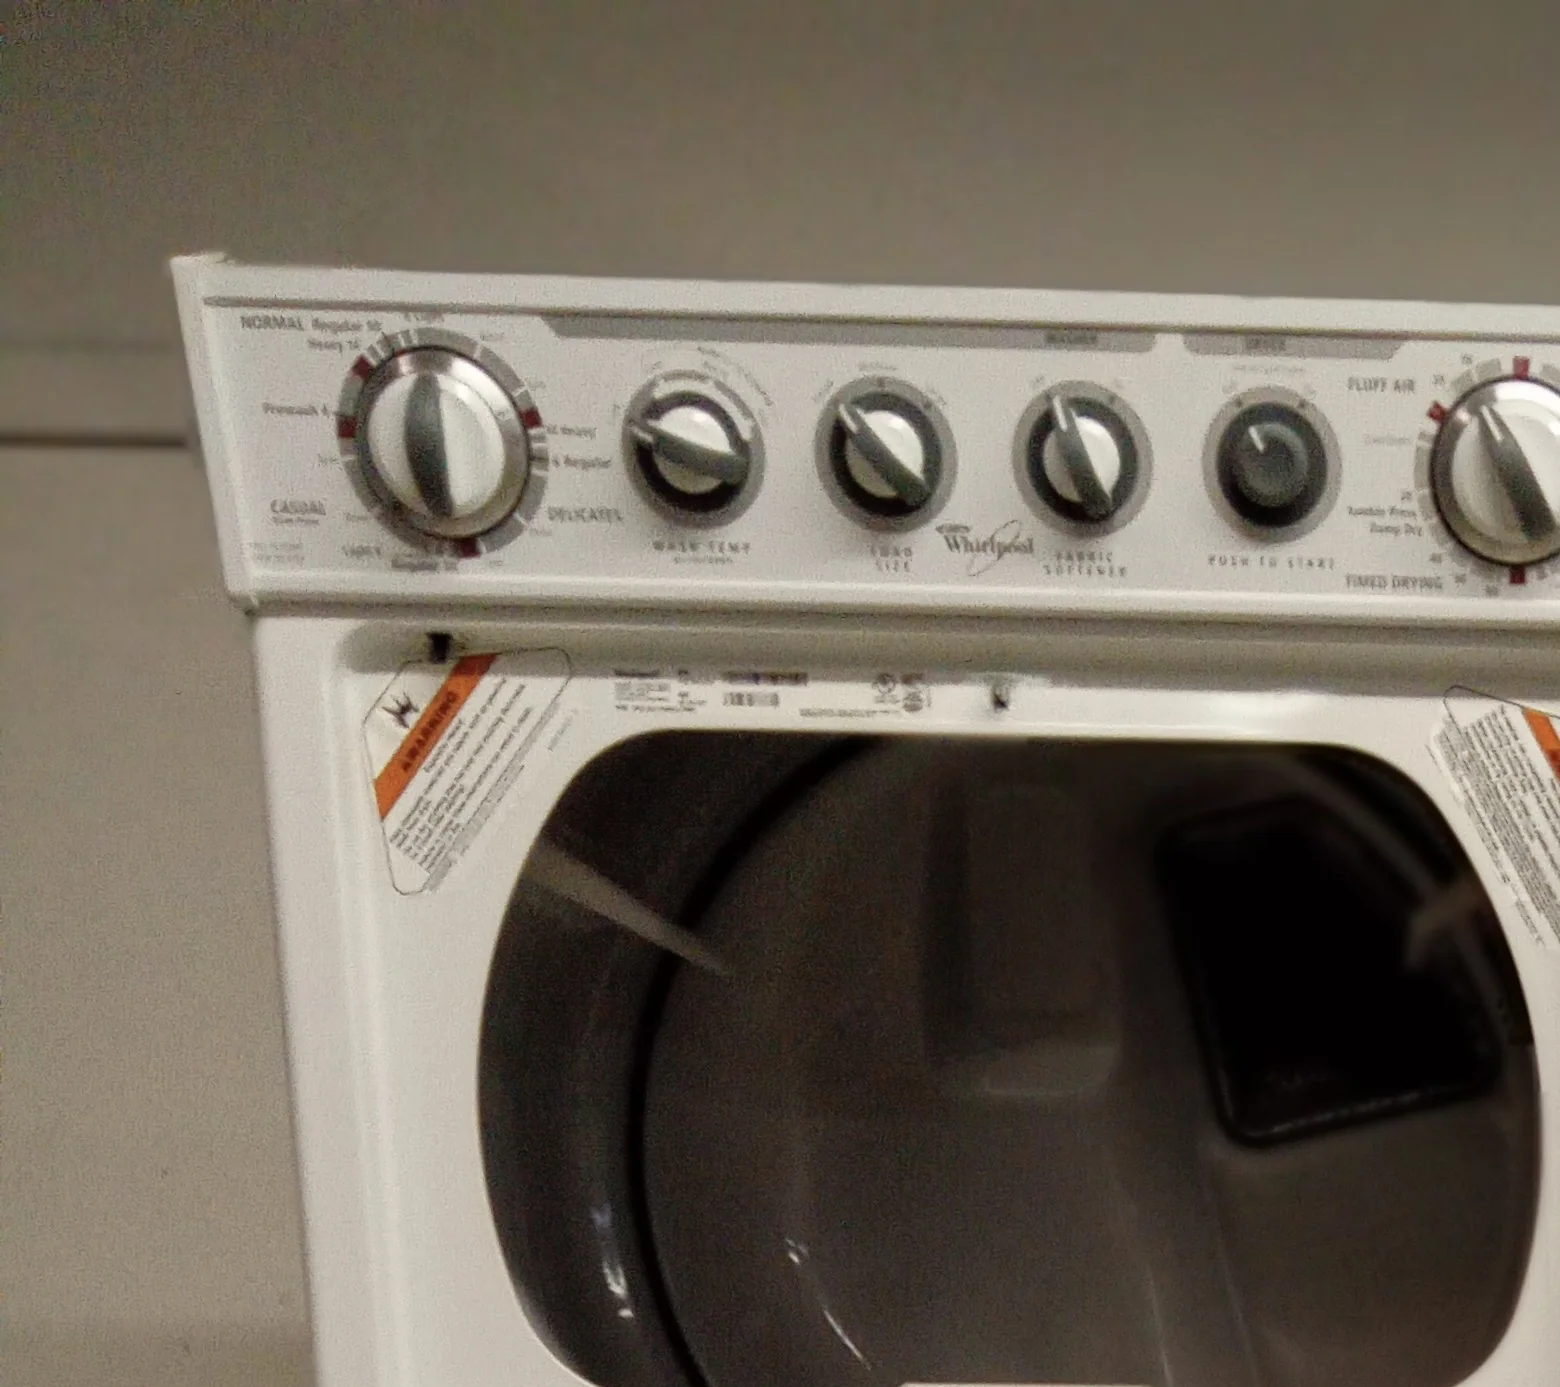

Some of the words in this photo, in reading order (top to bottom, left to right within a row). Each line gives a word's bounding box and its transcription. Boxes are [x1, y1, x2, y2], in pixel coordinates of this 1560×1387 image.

[241, 315, 304, 331] NORMAL
[1347, 376, 1387, 393] FLUFF
[1392, 378, 1416, 394] AIR
[270, 499, 326, 516] CASUAL
[943, 525, 1035, 565] Whirlpool
[1055, 550, 1114, 564] FABRIC
[1207, 555, 1250, 568] PUSH
[1286, 555, 1337, 571] START
[1345, 574, 1387, 590] TIMED
[1392, 574, 1444, 591] DRYING
